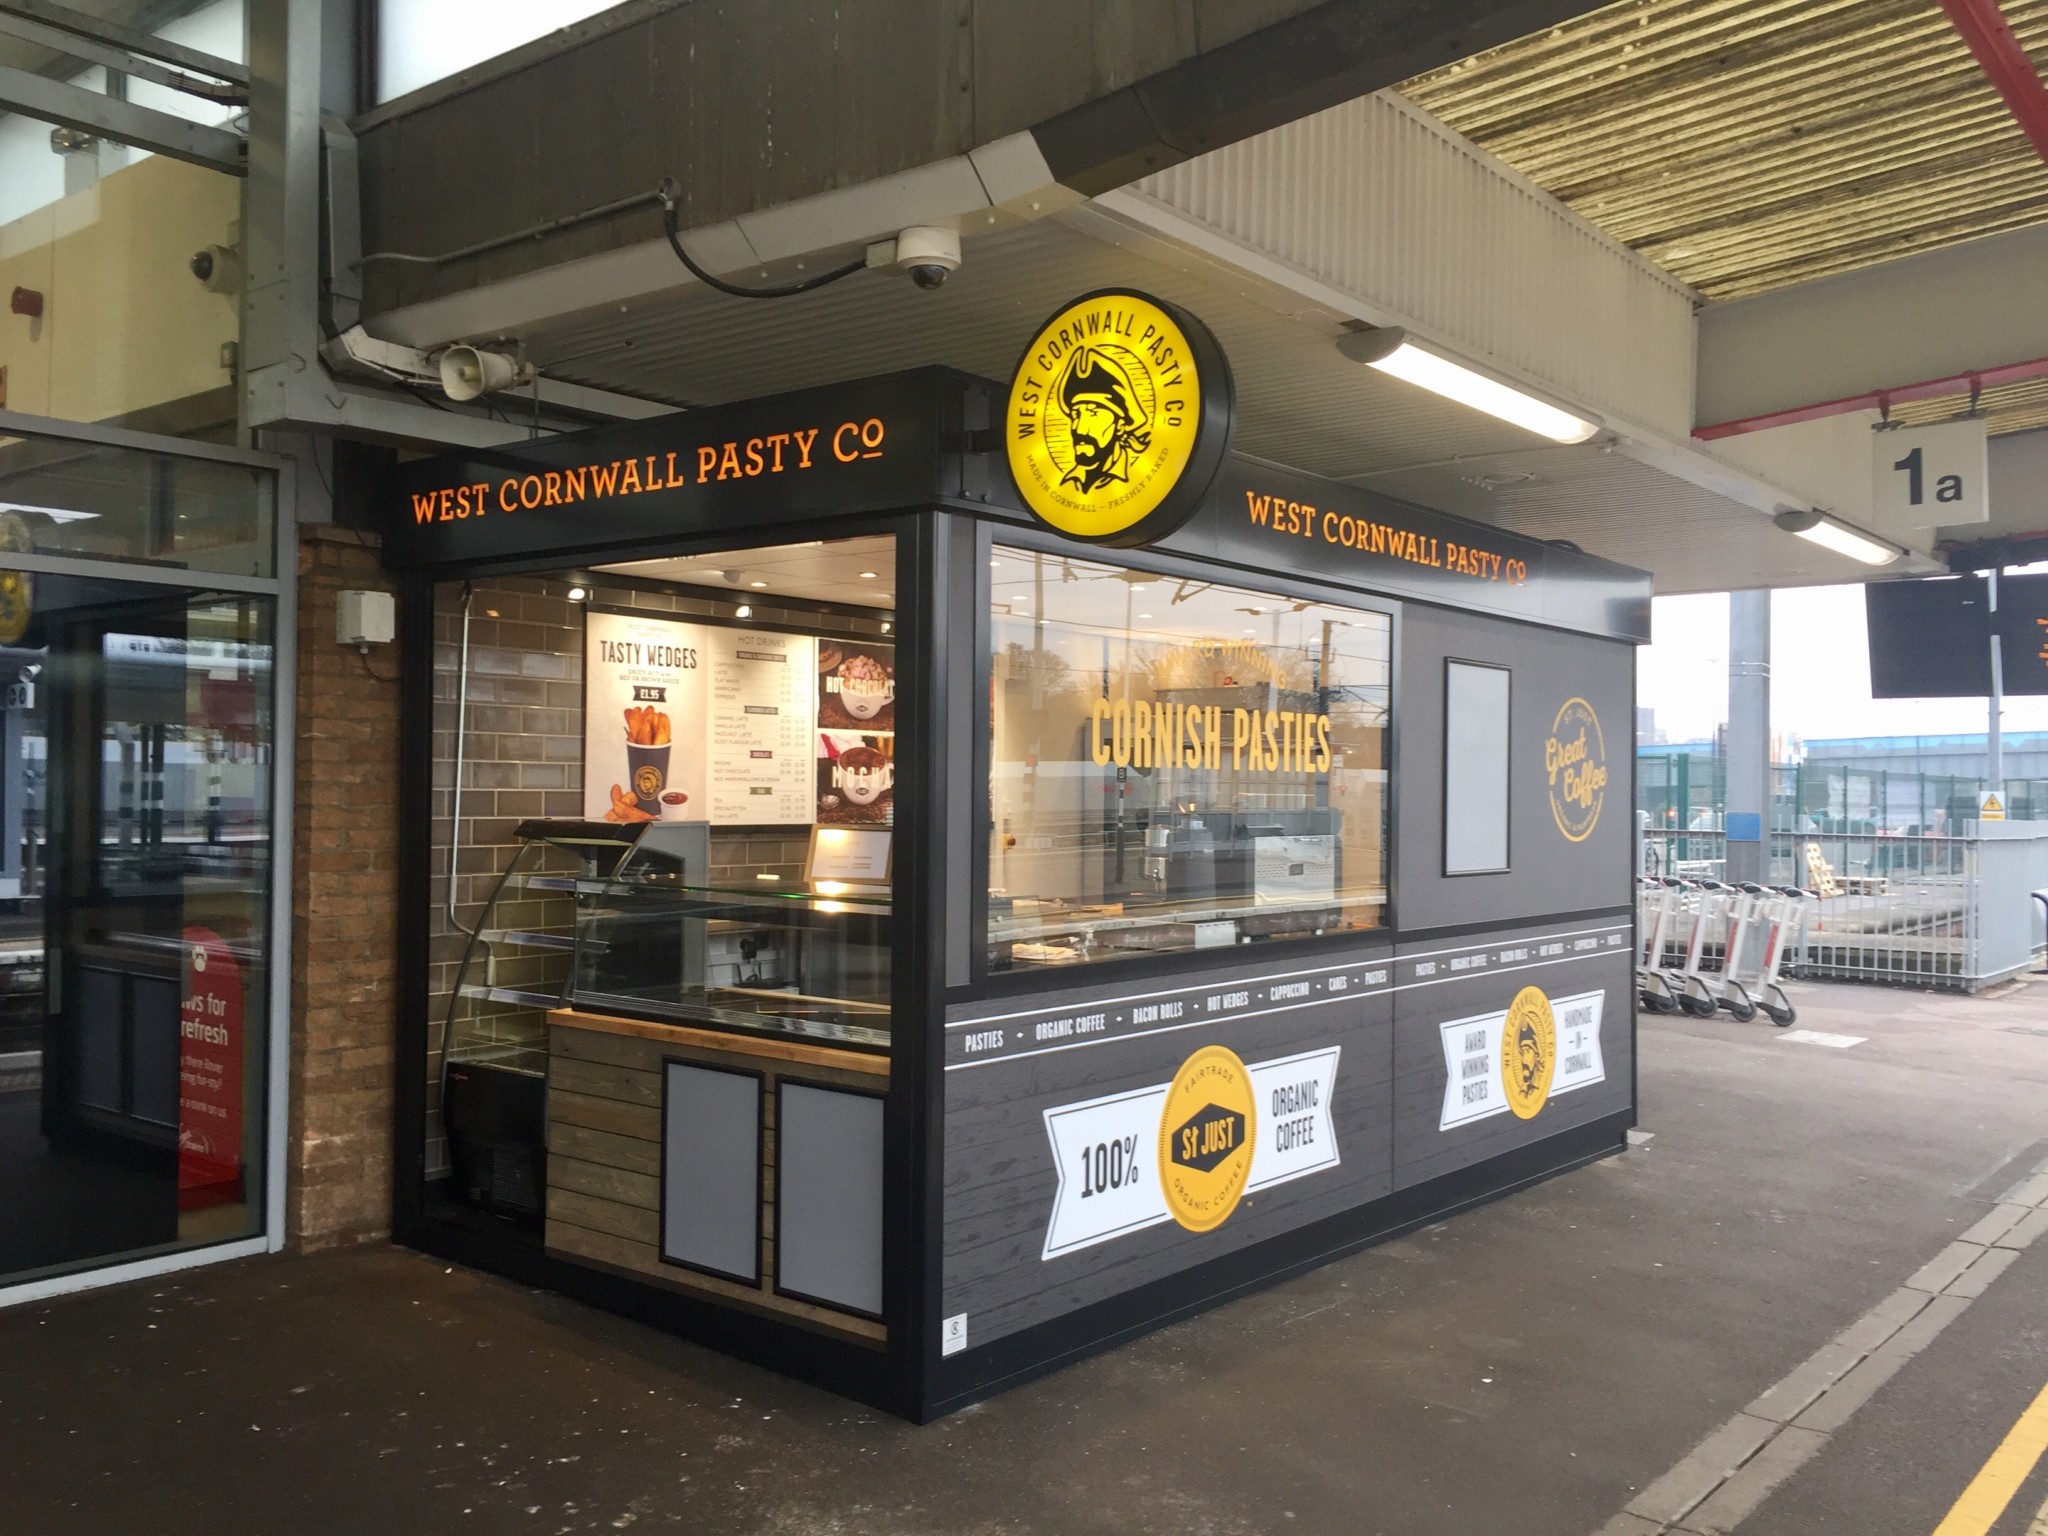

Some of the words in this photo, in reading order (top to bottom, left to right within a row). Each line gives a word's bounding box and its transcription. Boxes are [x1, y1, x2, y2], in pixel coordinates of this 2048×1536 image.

[1018, 376, 1043, 439] WEST
[1037, 310, 1135, 372] CORNWALL
[1139, 324, 1183, 389] PASTY
[413, 483, 489, 524] WEST
[500, 452, 683, 512] CORNWALL
[697, 428, 818, 484] PASTY
[1894, 447, 1963, 505] 1a
[1050, 490, 1097, 513] CORNWALL
[1108, 480, 1146, 509] FRESHLY
[1246, 491, 1316, 537] WEST
[1323, 512, 1441, 567] CORNWALL
[1446, 543, 1501, 581] PASTY
[600, 640, 641, 665] TASTY
[647, 644, 697, 669] WEDGES
[738, 636, 754, 646] HOT
[757, 637, 786, 648] DRINKS
[826, 676, 844, 694] HOT
[850, 678, 895, 697] CHOCOLAT
[1092, 698, 1221, 770] CORNISH
[1233, 707, 1331, 773] PASTIES
[1545, 726, 1588, 785] Great
[832, 764, 894, 788] MOCHA
[1564, 760, 1608, 809] Coffee
[207, 992, 226, 1016] for
[965, 1030, 1004, 1052] PASTIES
[1036, 1018, 1073, 1040] ORGANIC
[1075, 1013, 1106, 1034] COFFEE
[1133, 1005, 1158, 1024] BACON
[1160, 1001, 1183, 1019] ROLLS
[1207, 996, 1221, 1011] HOT
[1223, 991, 1249, 1009] WEDGES
[1270, 982, 1310, 1001] CAPPUCCINO
[1328, 976, 1347, 991] CAKES
[1365, 969, 1387, 985] PASTIES
[181, 1018, 228, 1046] refresh
[1184, 1065, 1234, 1093] FAIRTRADE
[1272, 1079, 1319, 1117] ORGANIC
[1462, 1080, 1488, 1105] PASTIES
[1201, 1116, 1235, 1155] JUST
[1276, 1115, 1314, 1153] COFFEE
[1081, 1134, 1139, 1199] 100%
[1174, 1178, 1209, 1211] ORGANIC
[1214, 1160, 1243, 1206] COFFEE
